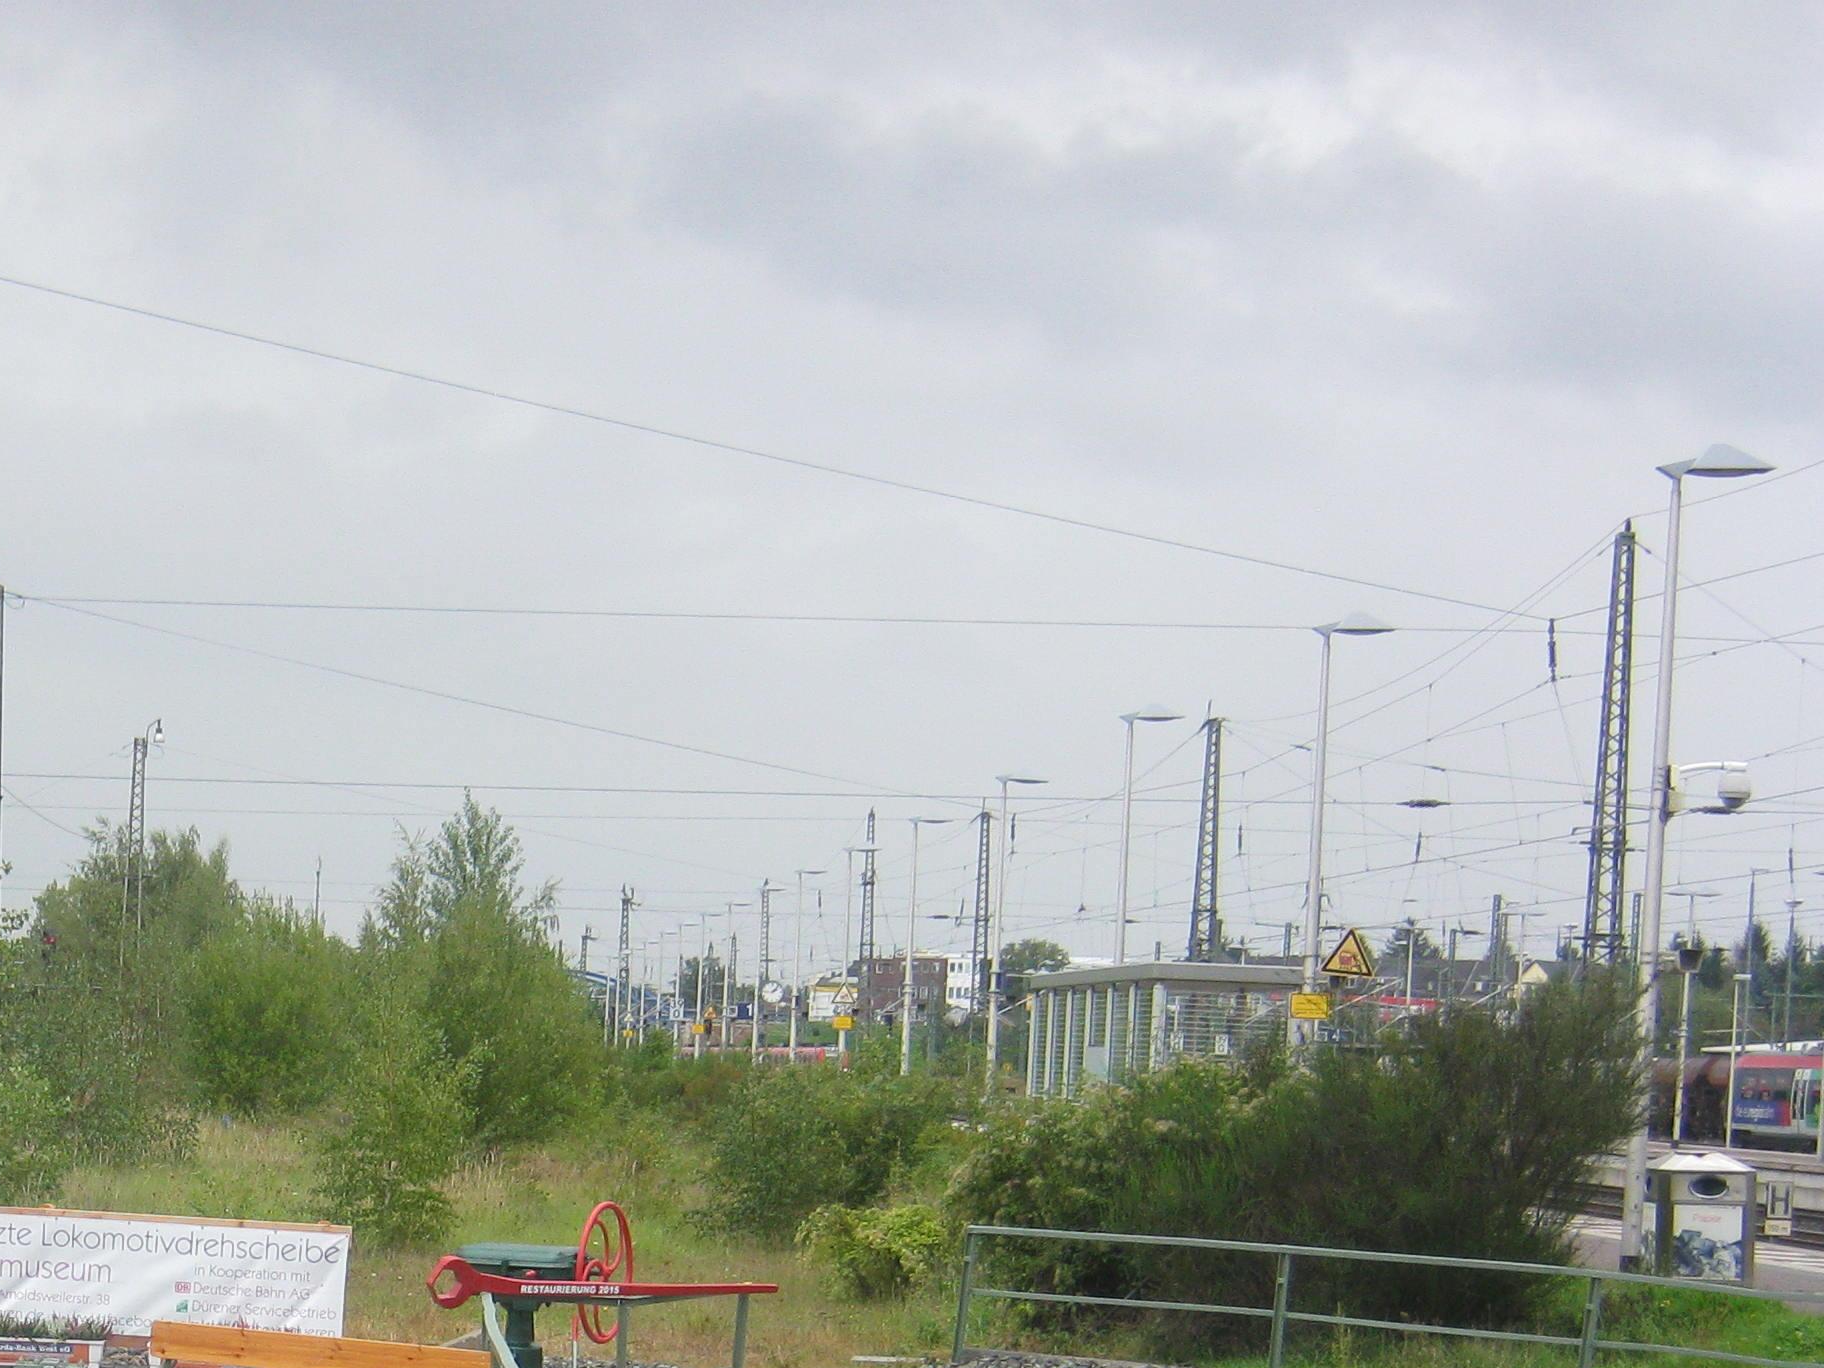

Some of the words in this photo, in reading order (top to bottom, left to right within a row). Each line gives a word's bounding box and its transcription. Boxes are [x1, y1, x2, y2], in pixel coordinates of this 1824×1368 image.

[1769, 1183, 1791, 1217] H
[42, 1222, 341, 1264] Lokomotivdrehscheibe
[194, 1266, 205, 1276] in
[208, 1265, 287, 1281] Kooperation
[290, 1271, 311, 1283] mit
[193, 1282, 253, 1297] Deutsche
[255, 1285, 286, 1299] Bahn
[288, 1288, 311, 1300] AG
[520, 1285, 596, 1294] RESTAURIERUNG
[598, 1285, 620, 1295] 2015
[95, 1293, 111, 1306] 38
[192, 1299, 241, 1314] Dürener
[245, 1303, 337, 1320] Servicebetrieb
[38, 1344, 58, 1353] West
